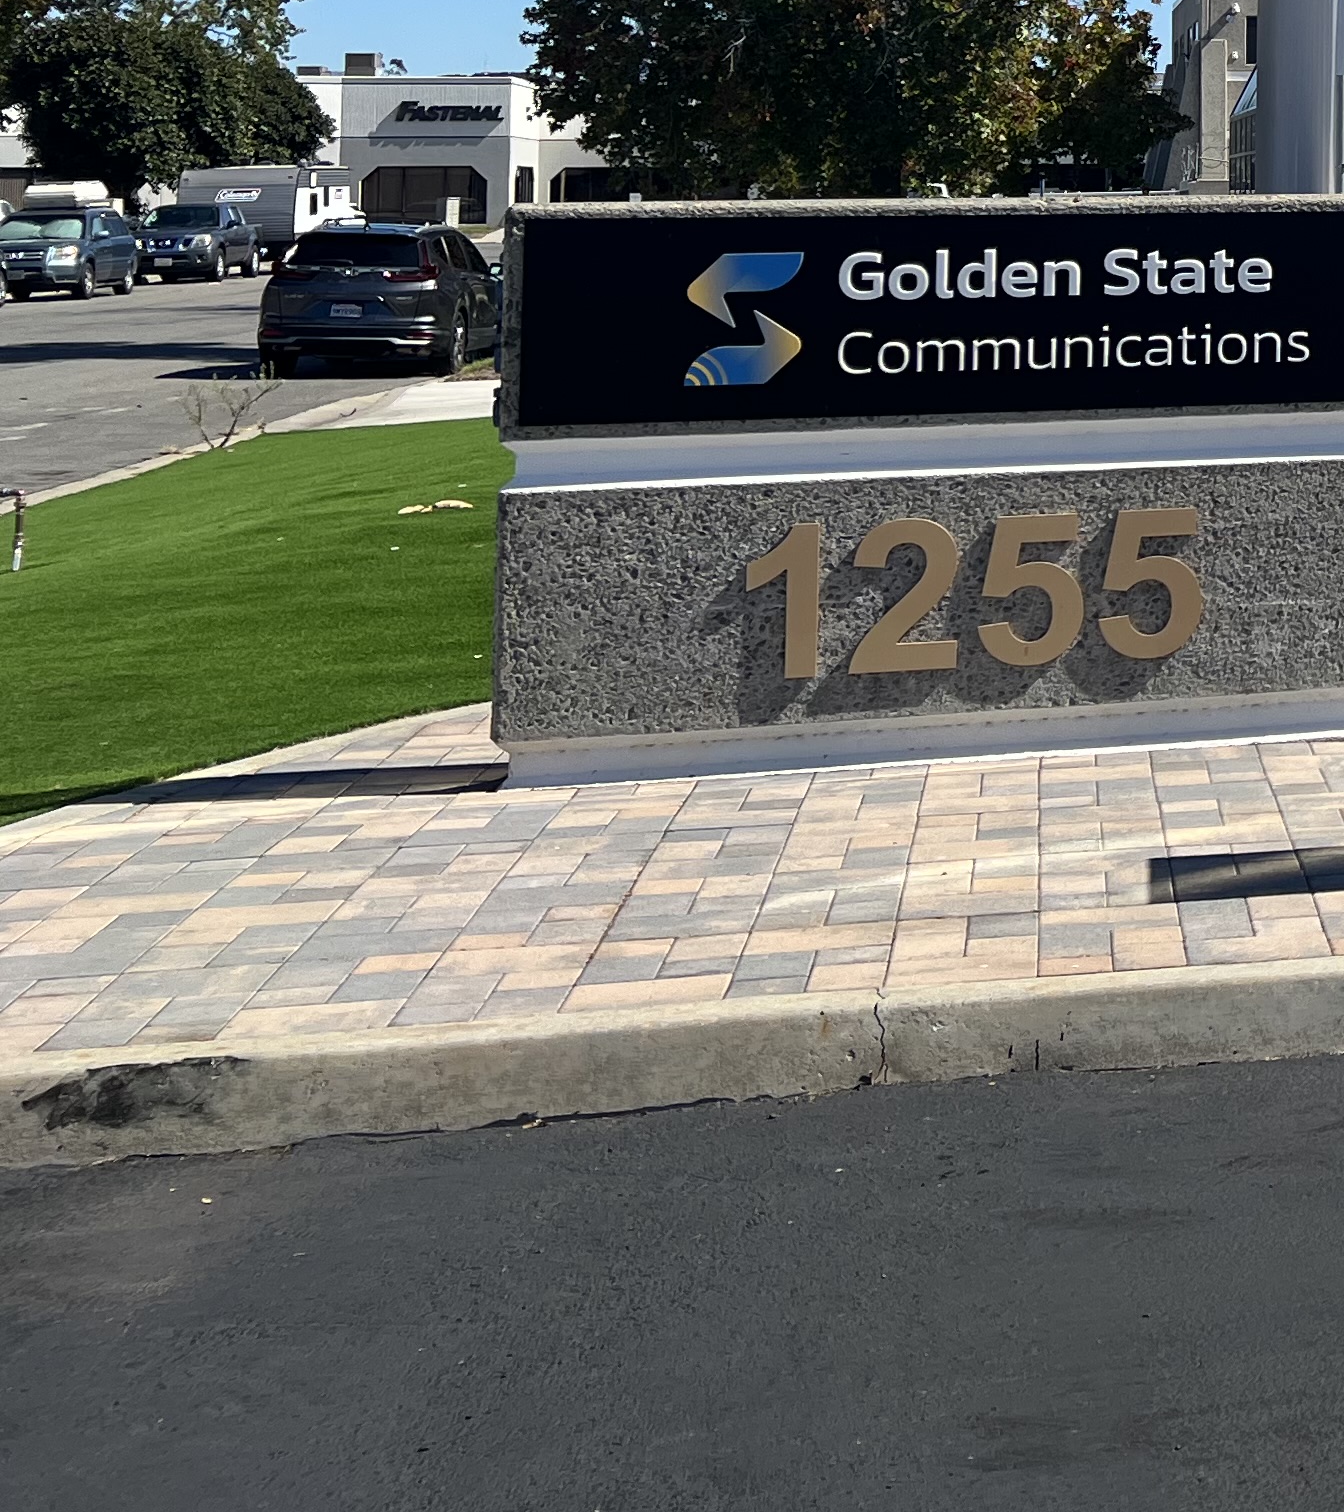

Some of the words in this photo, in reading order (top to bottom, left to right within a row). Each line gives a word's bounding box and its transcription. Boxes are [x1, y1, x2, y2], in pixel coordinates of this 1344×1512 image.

[395, 100, 504, 121] FASTENAL
[838, 248, 1081, 301] Golden
[1103, 248, 1273, 296] State
[838, 323, 1310, 374] Communications
[746, 507, 1201, 678] 1255
